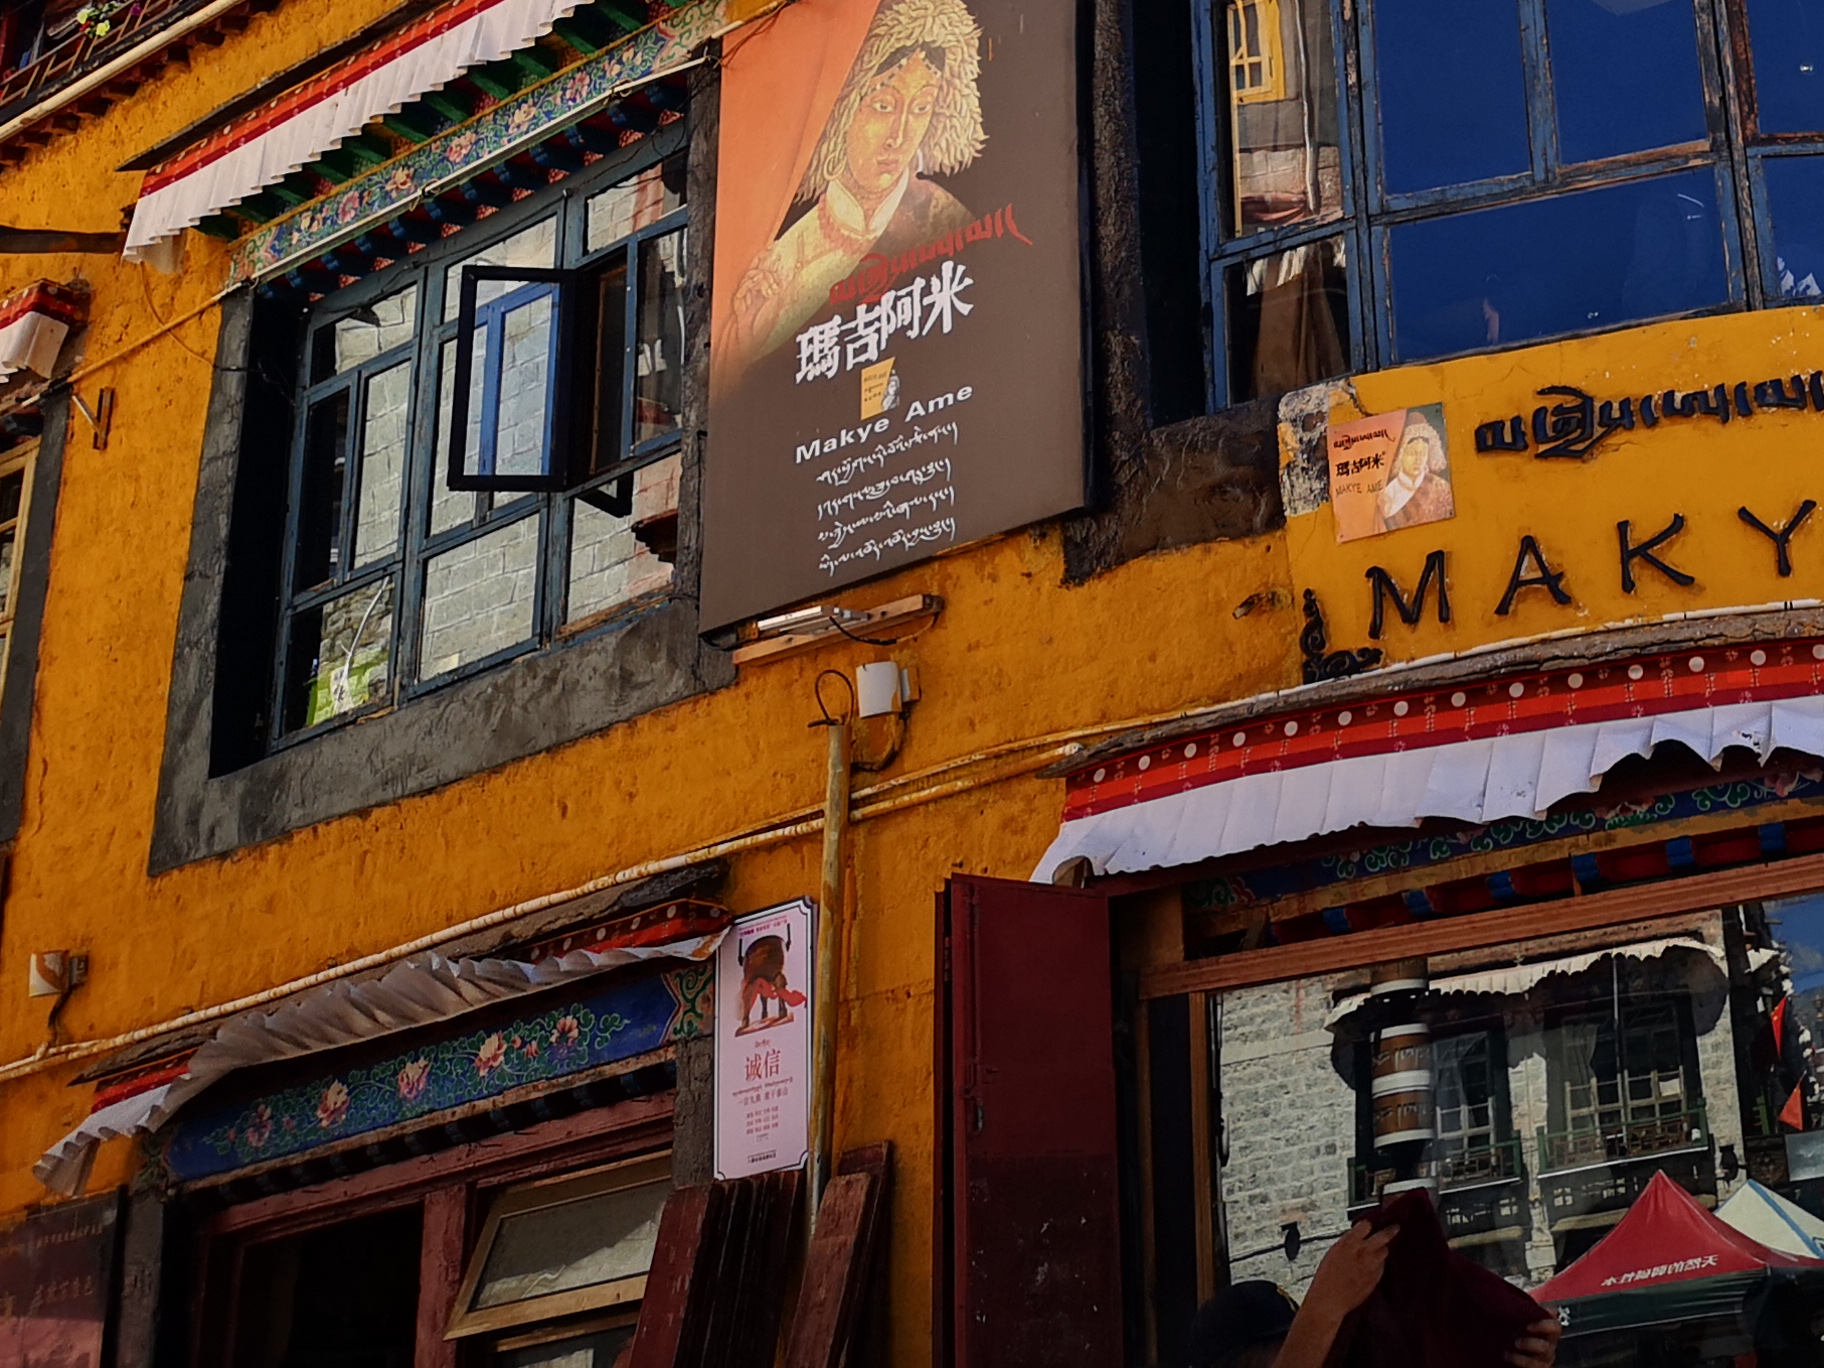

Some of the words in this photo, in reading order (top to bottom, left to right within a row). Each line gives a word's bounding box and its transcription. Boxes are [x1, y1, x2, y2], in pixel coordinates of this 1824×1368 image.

[796, 260, 974, 385] 瑪吉阿米
[795, 417, 890, 465] Makye
[904, 385, 973, 423] Ame
[744, 1048, 781, 1082] 诚信
